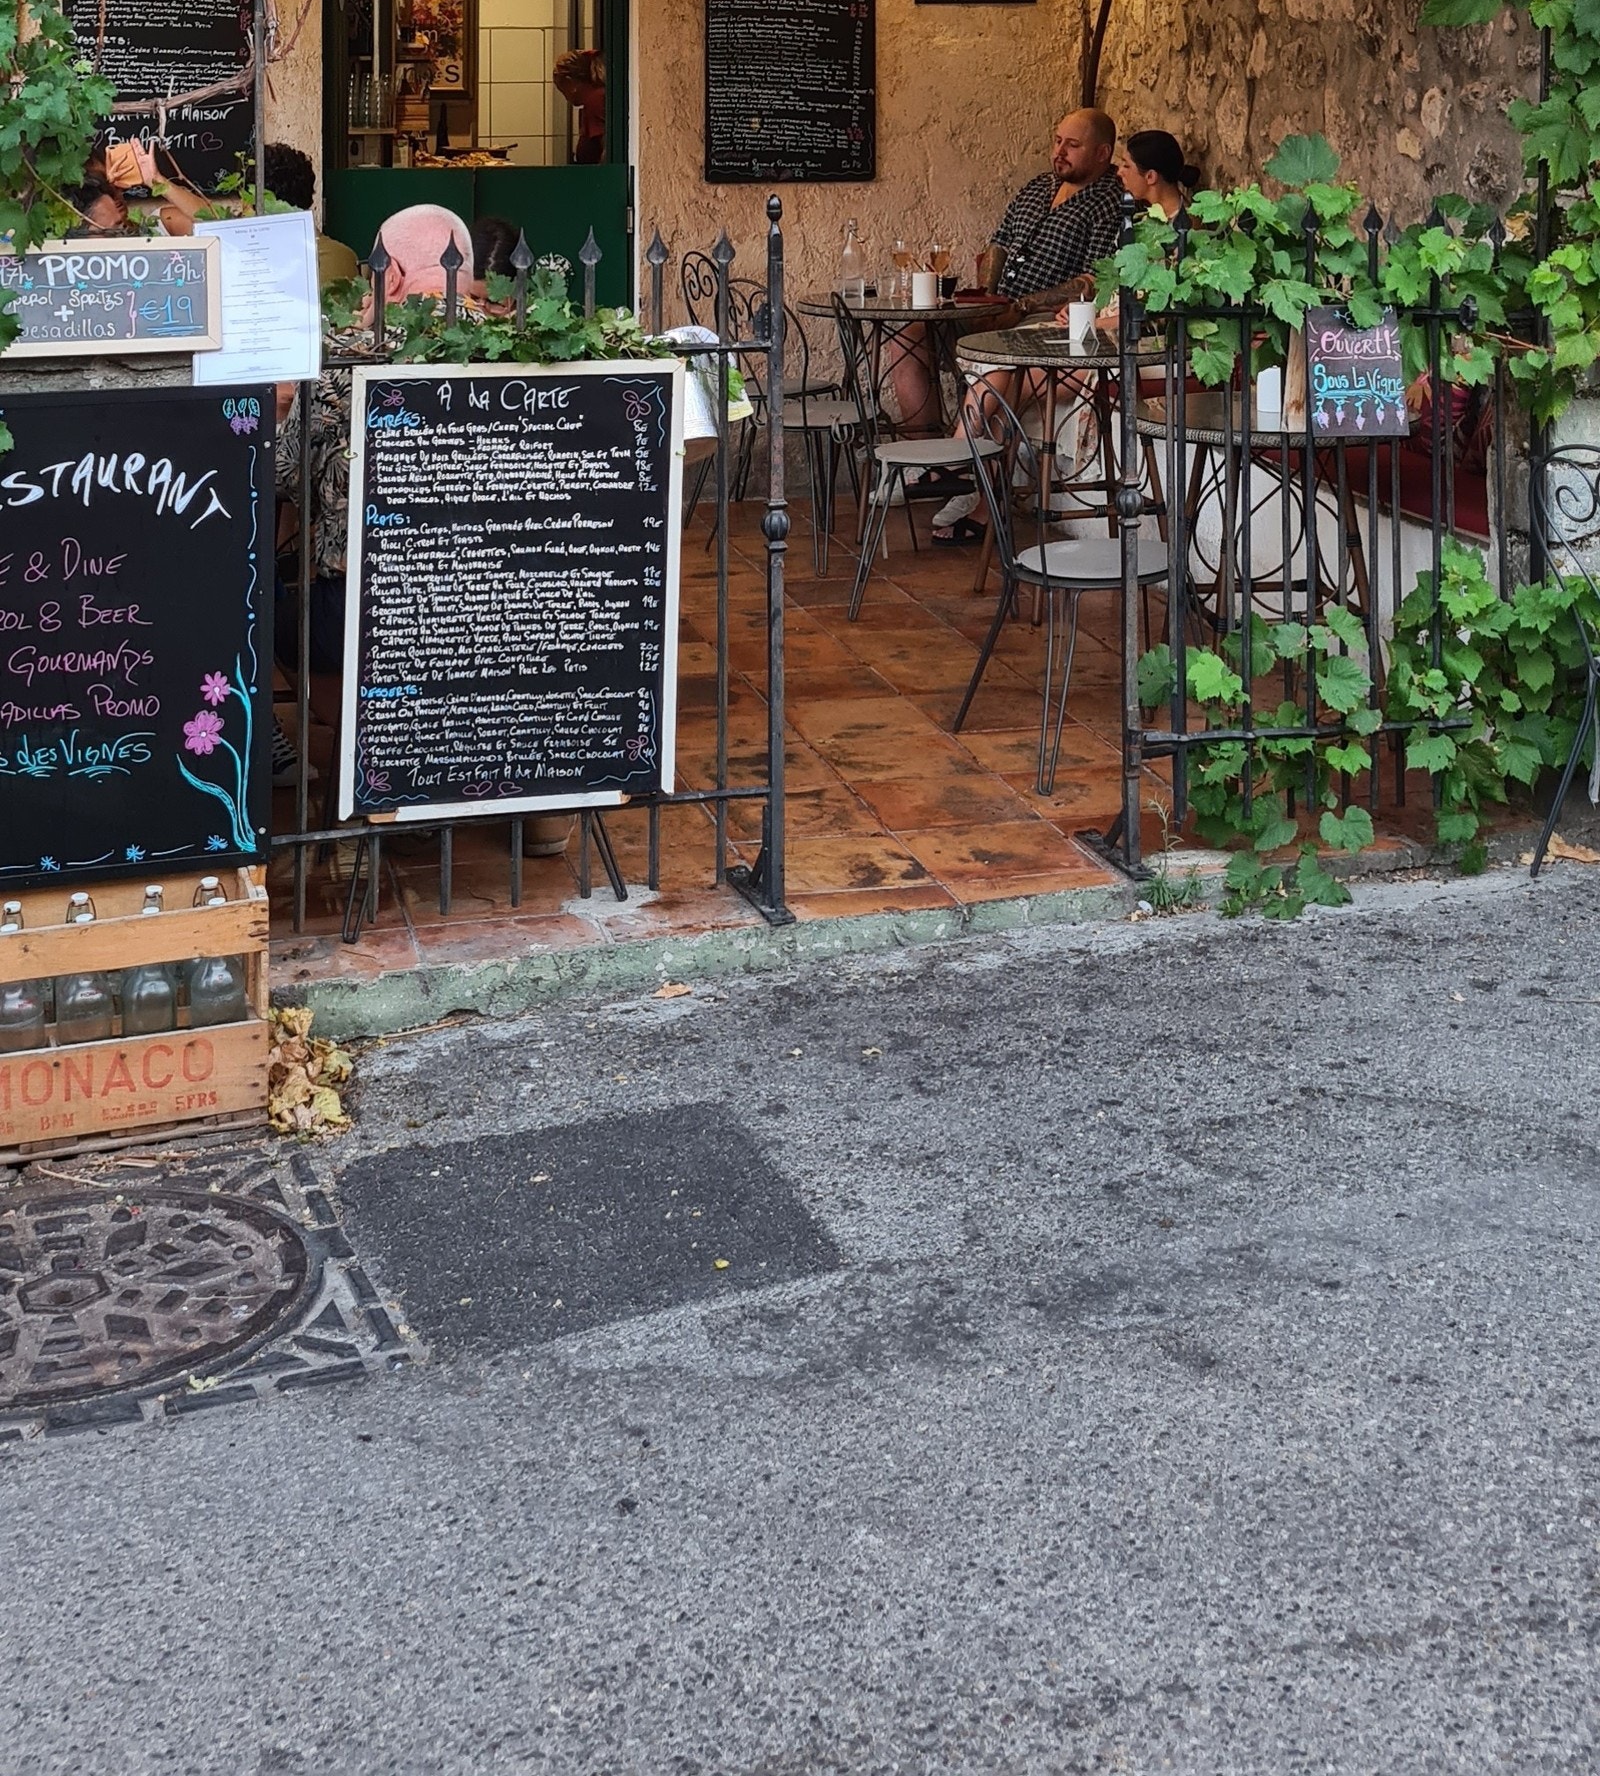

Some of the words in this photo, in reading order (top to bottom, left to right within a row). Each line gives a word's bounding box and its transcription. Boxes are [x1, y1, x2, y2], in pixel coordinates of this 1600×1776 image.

[181, 104, 234, 121] MAISON
[38, 255, 149, 286] PROMO
[8, 289, 53, 312] perol
[139, 295, 194, 325] €19
[22, 319, 116, 339] uesadillas
[1314, 363, 1350, 392] Sous
[1366, 368, 1405, 395] Vigne
[500, 380, 581, 415] CARTE
[0, 452, 232, 530] STAURANT
[366, 504, 410, 526] PLATS:
[61, 537, 128, 580] DINE
[78, 594, 153, 629] BEER
[8, 639, 154, 687] GOURMANDS
[87, 683, 160, 717] PROMO
[360, 685, 423, 697] DESSERTS:
[60, 729, 156, 764] VIGNES
[407, 766, 442, 786] TOUT
[447, 765, 472, 782] EST
[475, 764, 500, 780] FAIT
[535, 763, 585, 778] MAISON
